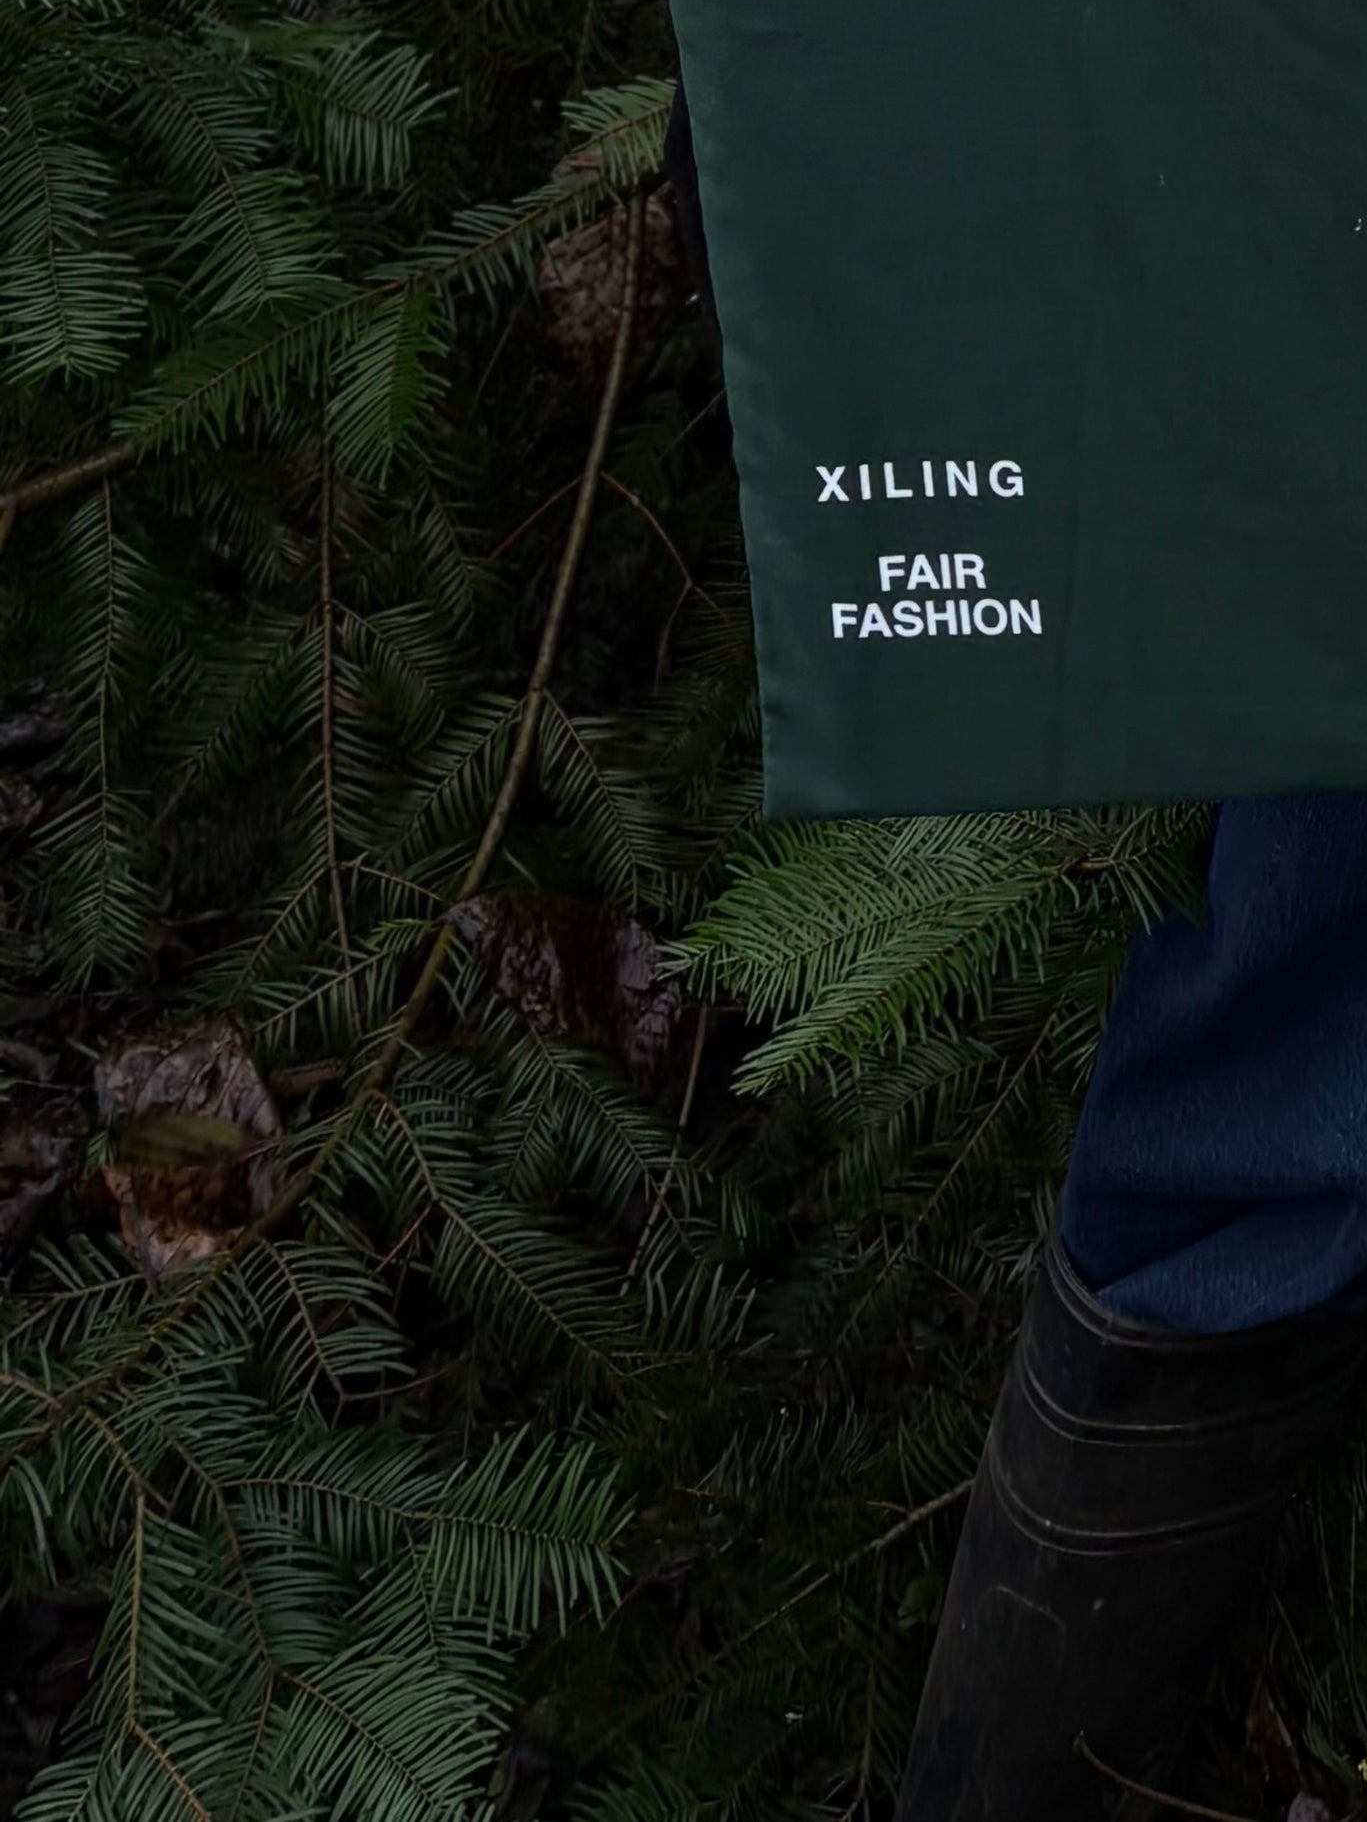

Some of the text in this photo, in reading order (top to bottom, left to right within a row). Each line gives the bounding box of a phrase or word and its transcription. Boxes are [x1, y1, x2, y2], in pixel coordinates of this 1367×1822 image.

[815, 459, 1024, 503] XILING
[878, 553, 987, 592] FAIR
[831, 598, 1043, 639] FASHION
